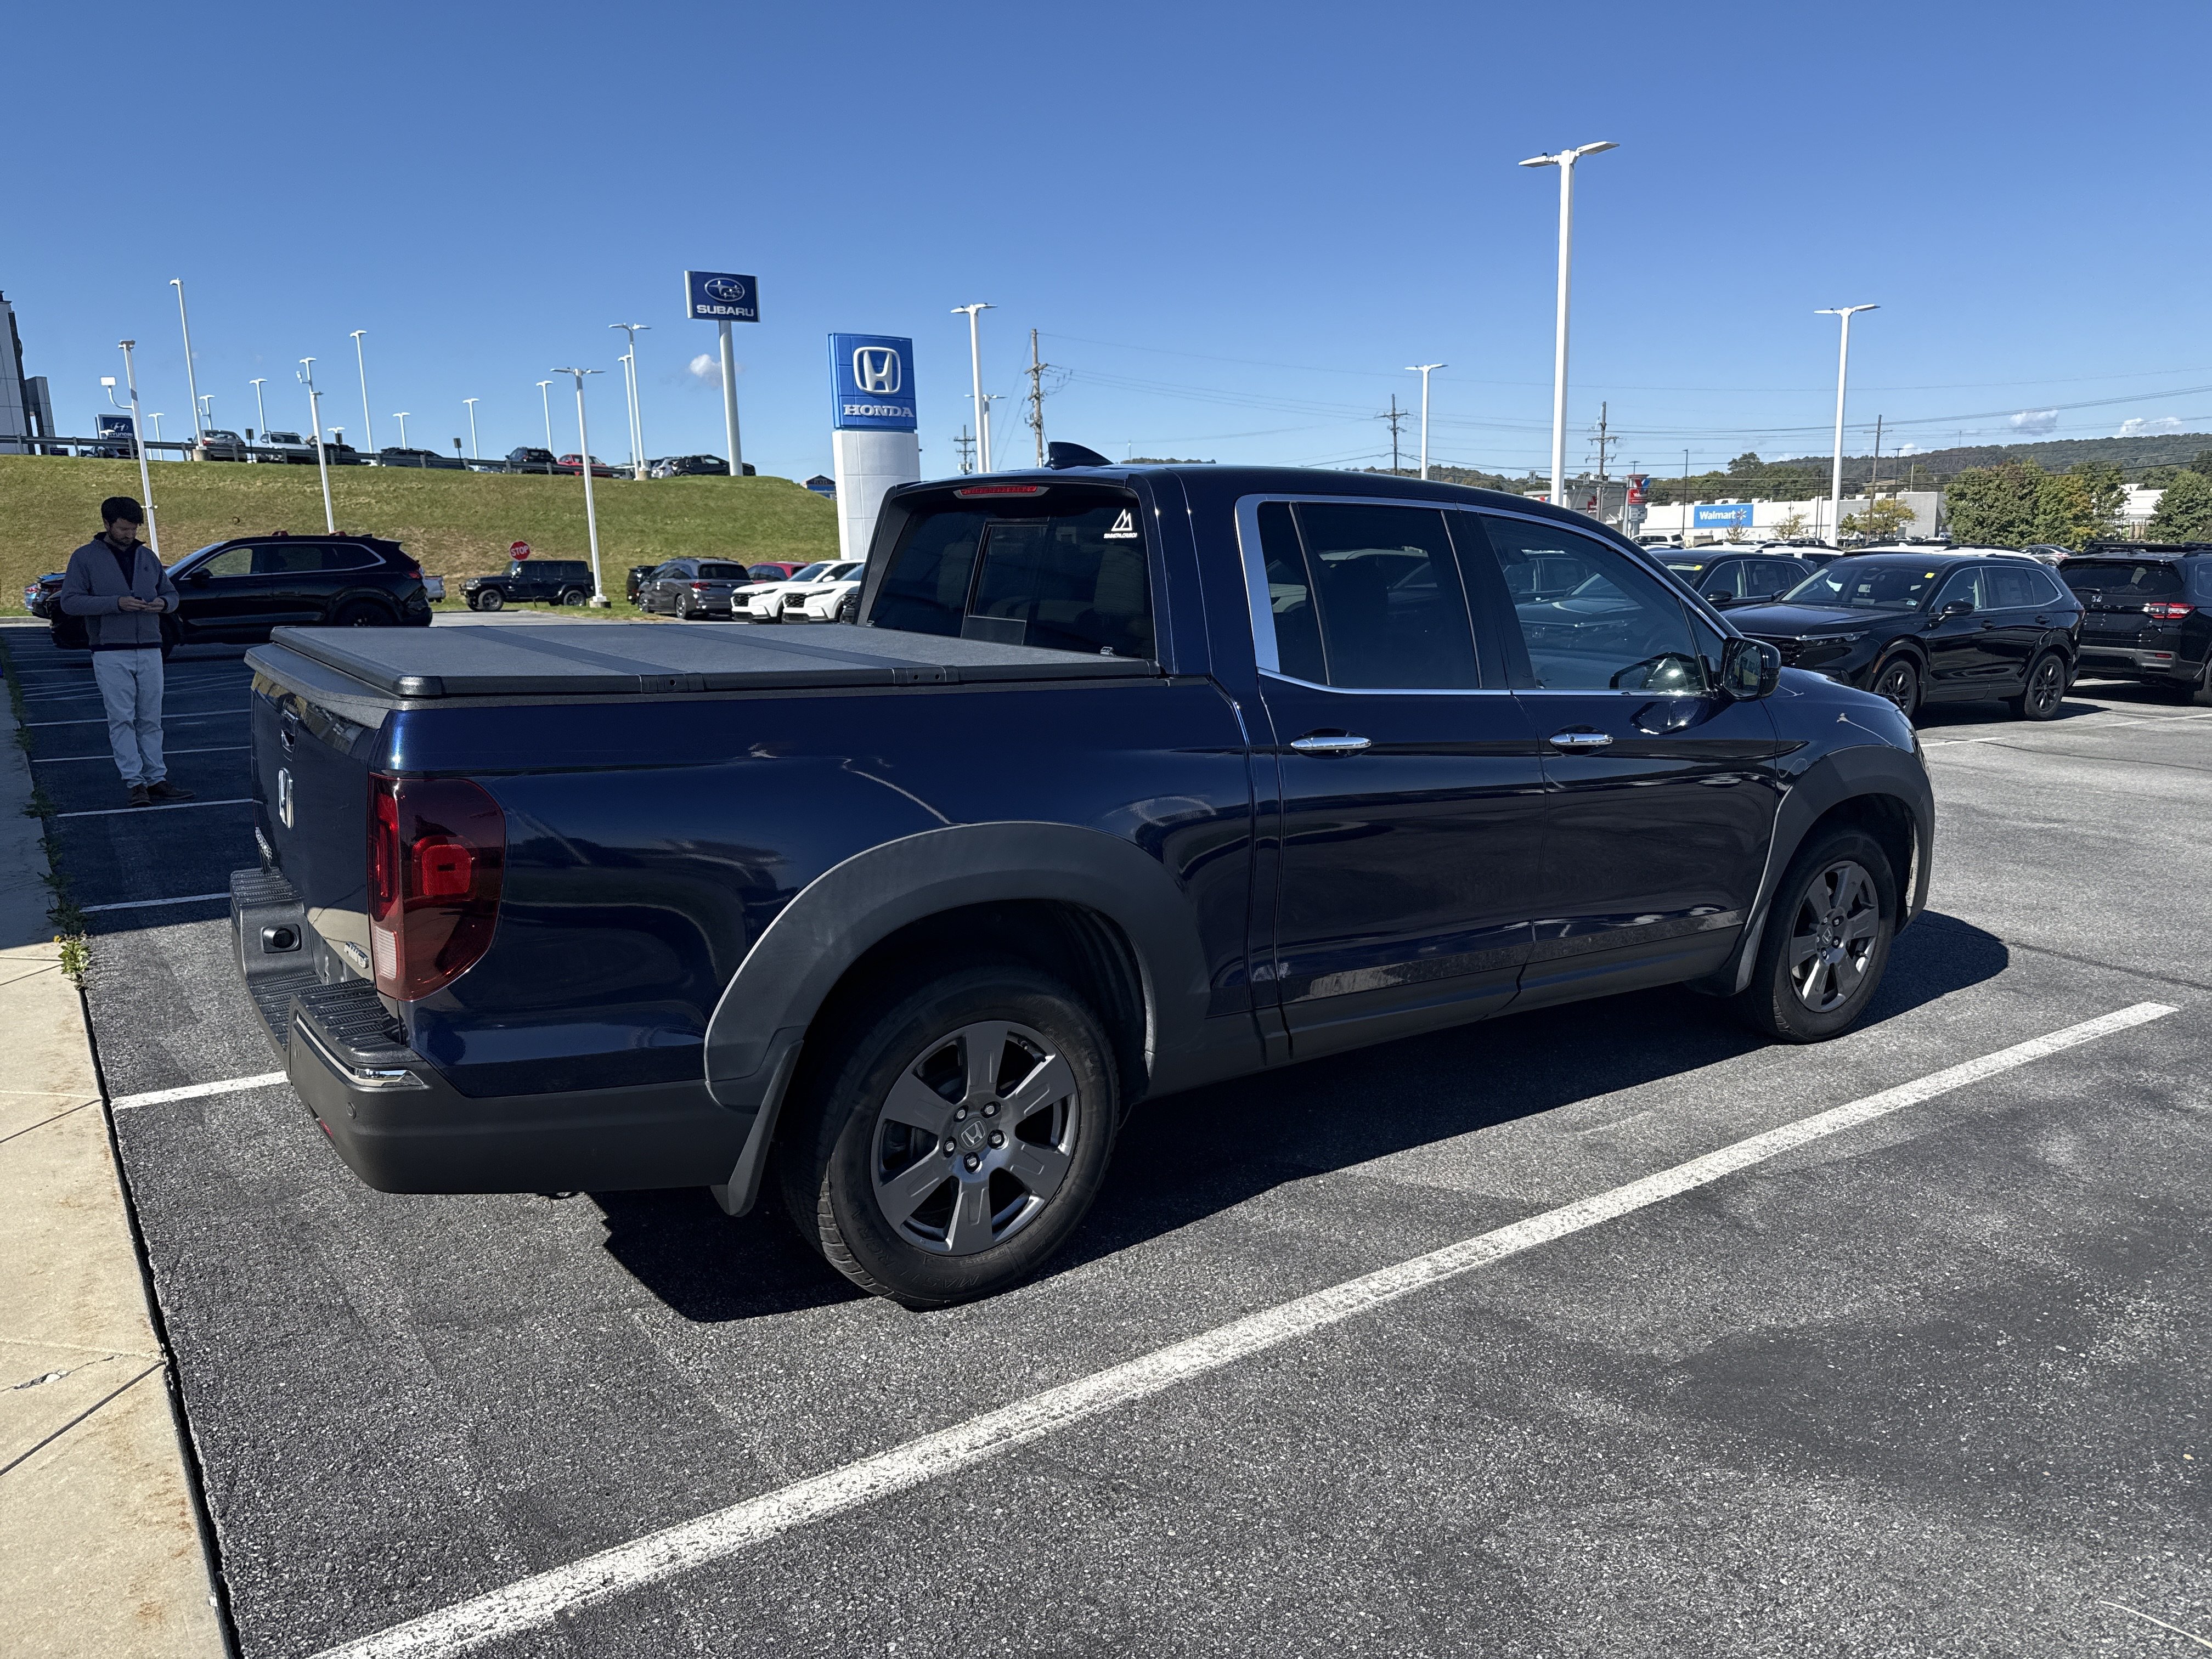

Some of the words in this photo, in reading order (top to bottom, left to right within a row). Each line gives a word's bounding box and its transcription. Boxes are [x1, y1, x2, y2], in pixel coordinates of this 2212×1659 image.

[696, 304, 754, 317] SUBARU
[843, 405, 915, 418] HONDA
[1700, 510, 1736, 520] Walmart
[511, 545, 528, 556] STOP
